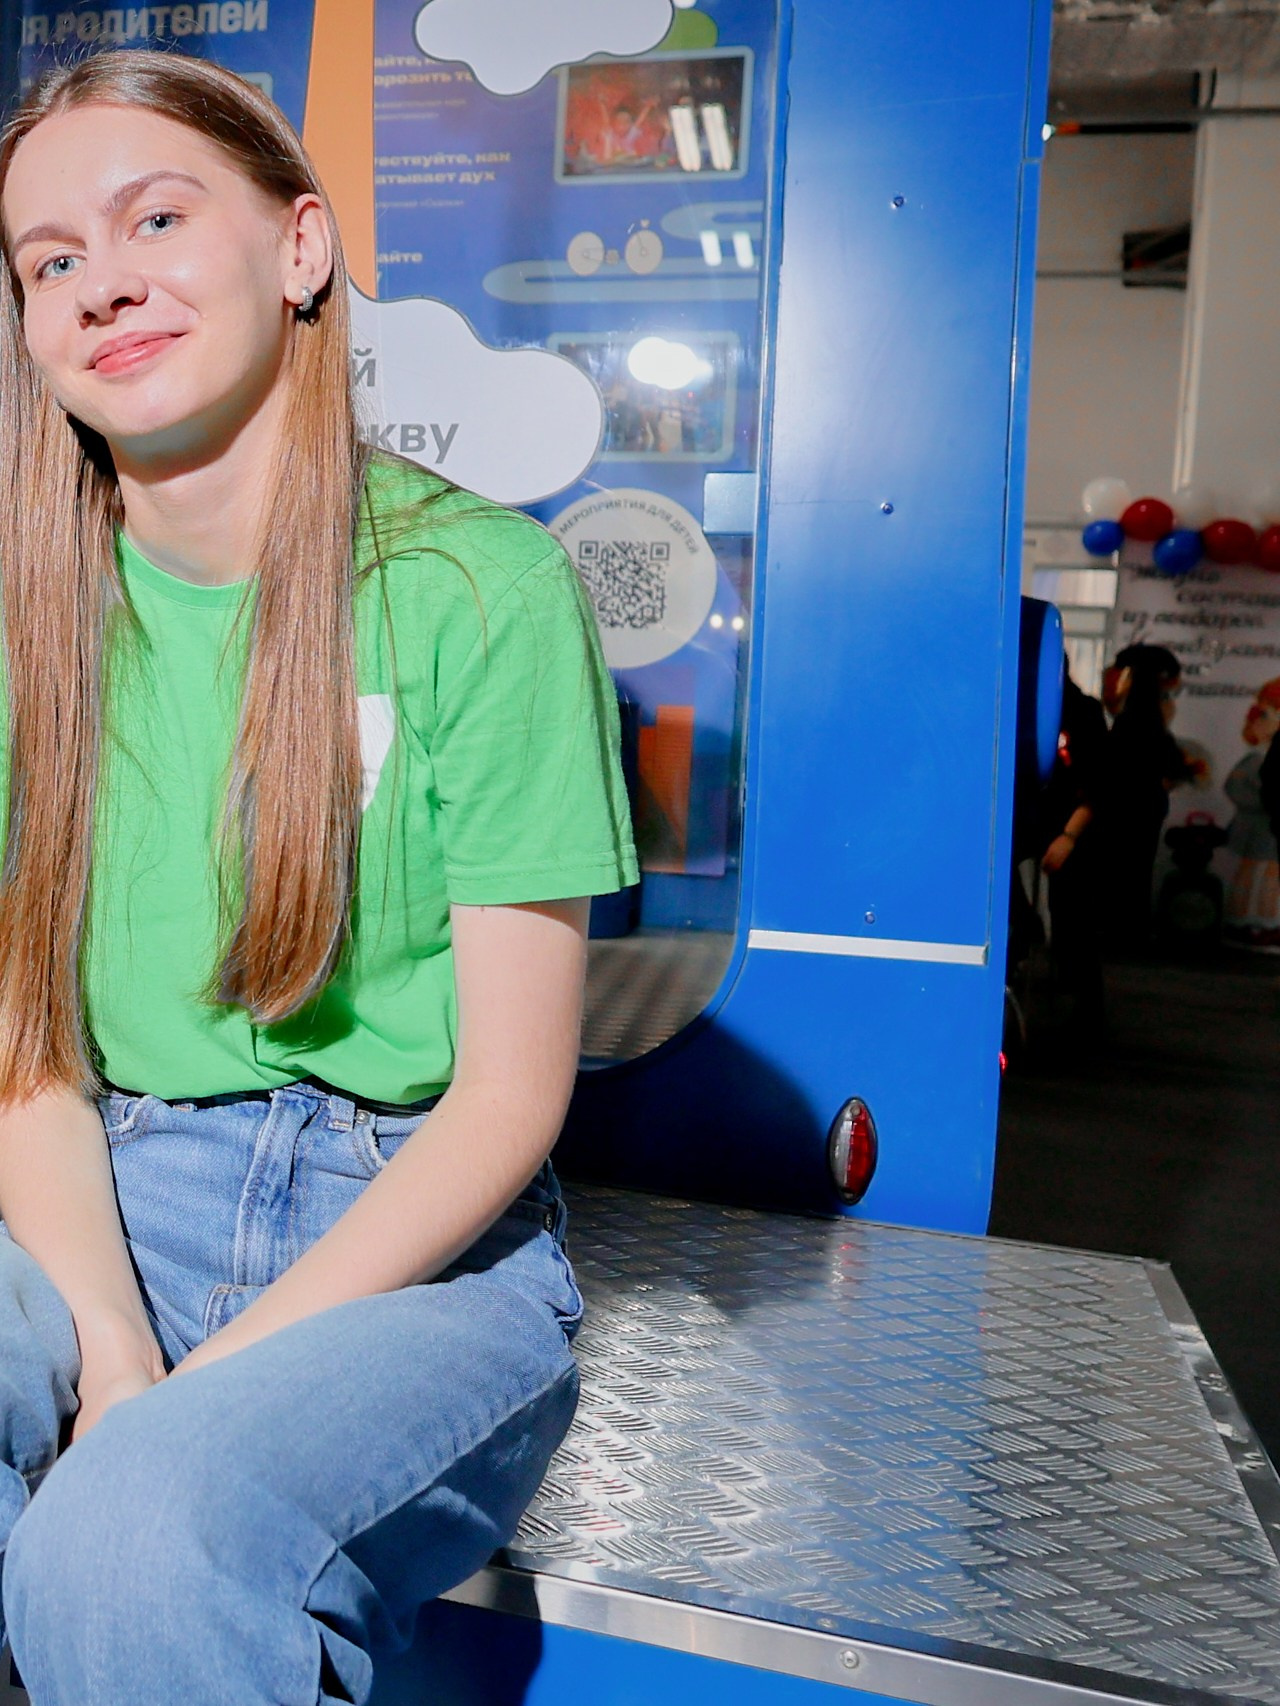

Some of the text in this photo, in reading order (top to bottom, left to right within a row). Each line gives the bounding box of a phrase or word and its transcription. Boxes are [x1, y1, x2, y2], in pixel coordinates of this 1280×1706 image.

[476, 151, 512, 163] как
[460, 170, 496, 185] дух
[357, 423, 460, 465] кву
[559, 498, 699, 555] МЕРОПРИЯТИЯ ДЛЯ ДЕТЕЙ
